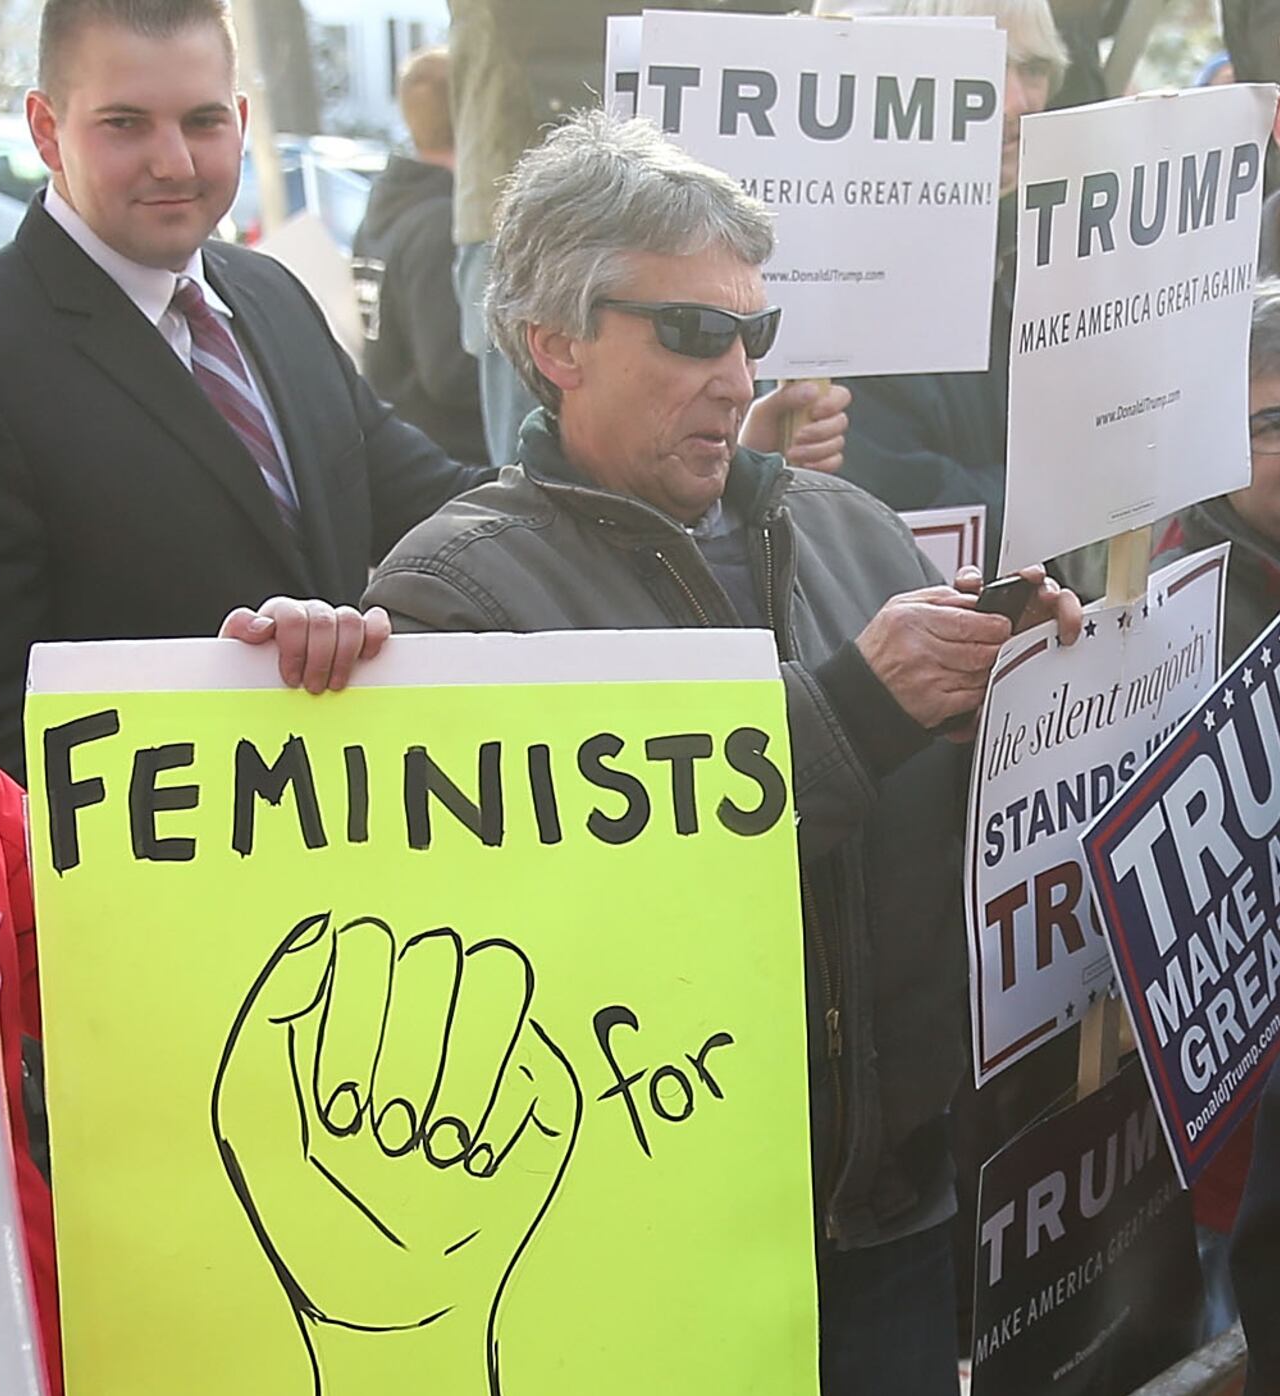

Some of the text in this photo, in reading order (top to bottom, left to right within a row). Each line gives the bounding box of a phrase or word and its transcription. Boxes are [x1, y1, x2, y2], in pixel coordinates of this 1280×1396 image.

[648, 65, 998, 142] TRUMP
[739, 178, 992, 206] MERICA GREAT AGAIN!
[1026, 142, 1260, 267] TRUMP
[1019, 262, 1254, 355] MAKE AMERICA GREAT AGAIN!
[987, 711, 1026, 781] the
[1030, 682, 1123, 756] silent
[1124, 624, 1211, 721] majority
[43, 708, 789, 877] FEMINISTS
[984, 750, 1137, 868] STANDS
[1144, 866, 1266, 1048] MAKE
[591, 1003, 736, 1159] for
[980, 1099, 1160, 1288] TRUM
[975, 1306, 1022, 1366] MAKE
[1026, 1250, 1103, 1326] AMERICA
